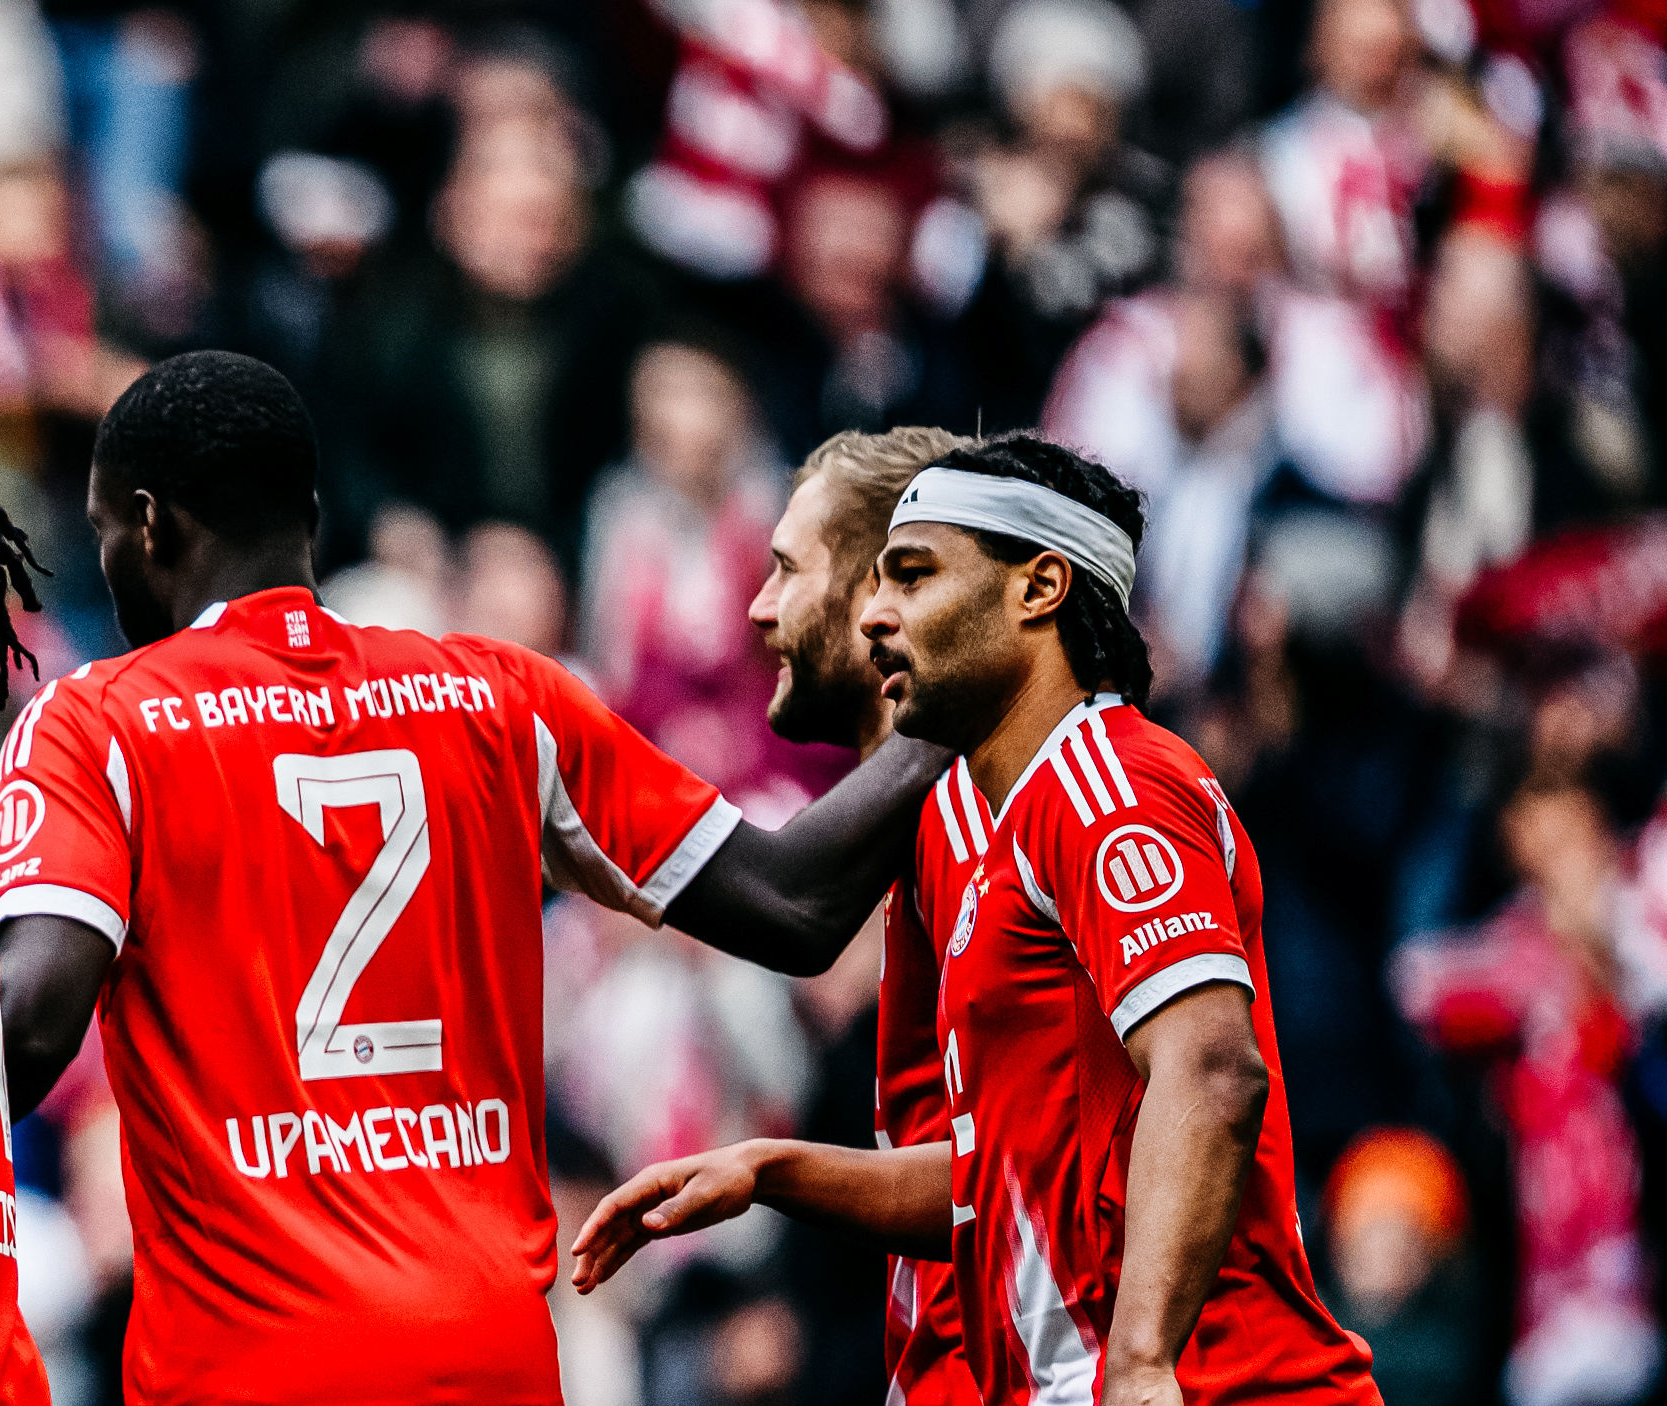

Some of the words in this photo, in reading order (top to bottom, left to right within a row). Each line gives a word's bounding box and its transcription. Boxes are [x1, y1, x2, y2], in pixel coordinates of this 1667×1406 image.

[140, 697, 191, 732] FC
[195, 685, 335, 728] BAYERN
[343, 672, 496, 721] MÜNCHEN
[273, 748, 442, 1081] 2
[1118, 908, 1219, 966] Allianz
[225, 1098, 511, 1179] UPAMECANO
